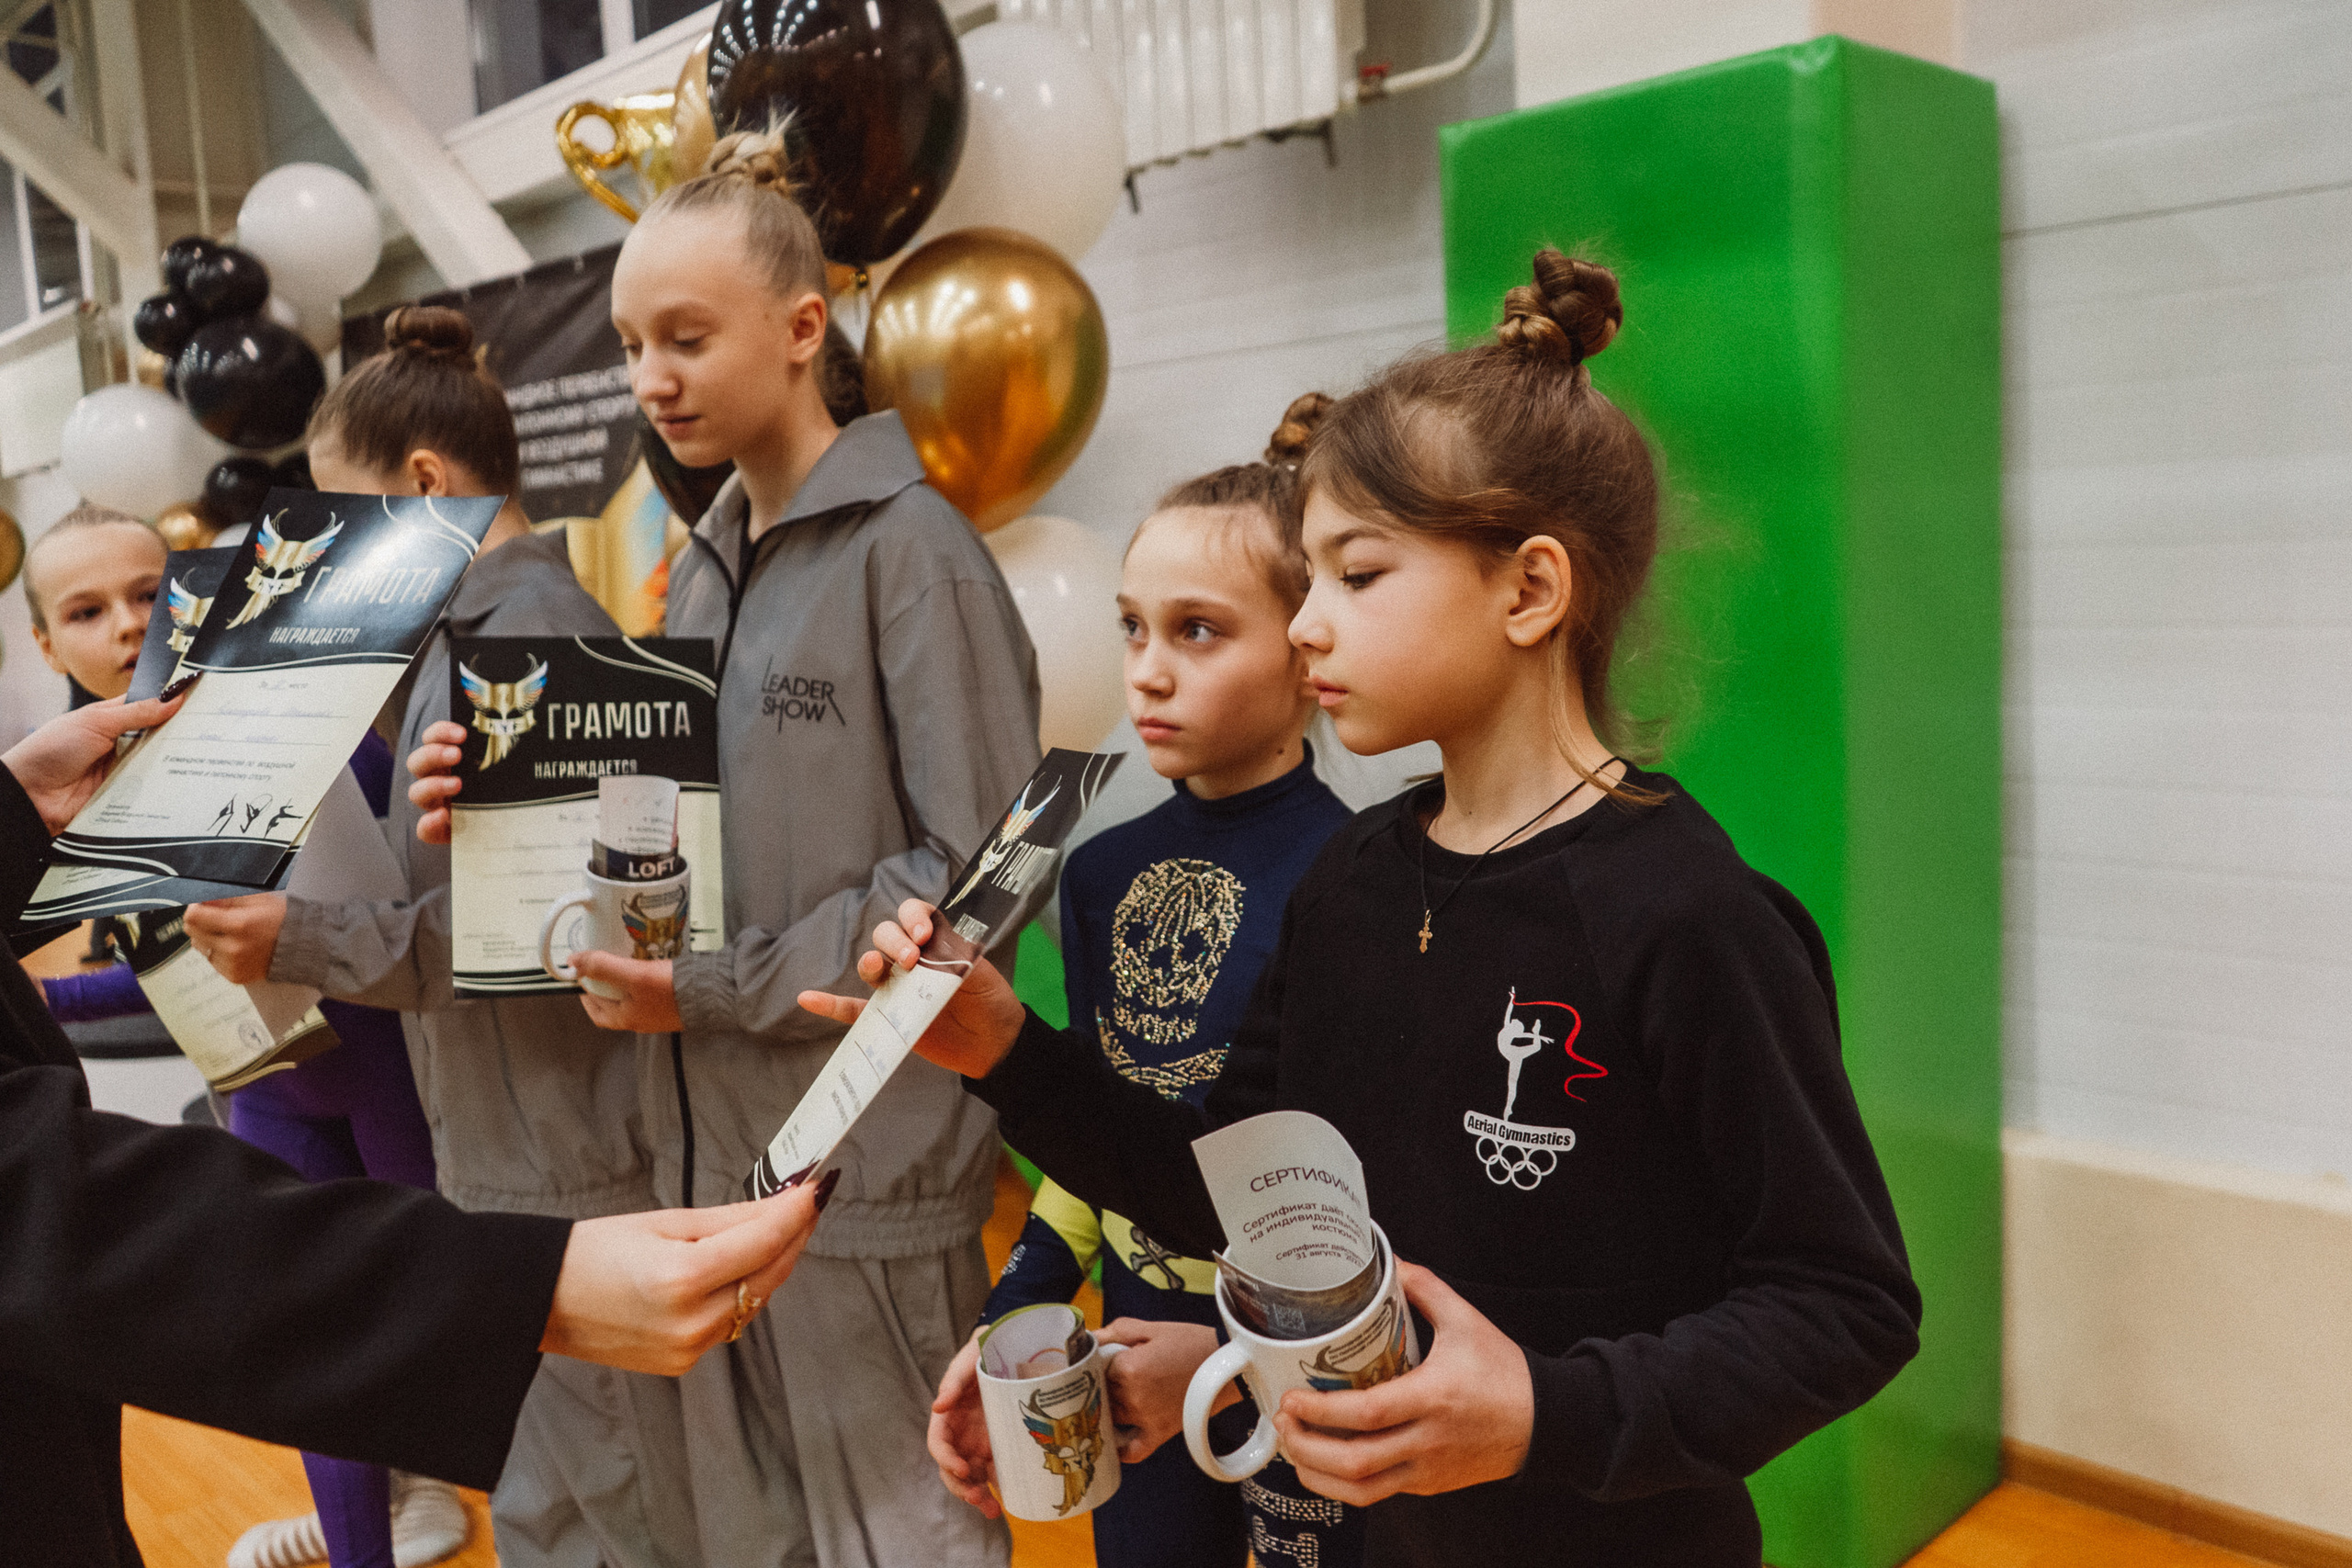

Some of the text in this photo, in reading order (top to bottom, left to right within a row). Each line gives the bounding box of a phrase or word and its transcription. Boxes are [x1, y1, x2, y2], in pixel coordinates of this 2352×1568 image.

[303, 566, 442, 604] ГРАМОТА
[269, 626, 360, 646] НАГРАЖДАЕТСЯ
[761, 654, 845, 727] LEADER
[548, 701, 691, 740] ГРАМОТА
[762, 694, 826, 733] SHOW
[534, 759, 638, 779] НАГРАЖДАЕТСЯ
[628, 857, 675, 878] LOFT
[1498, 1124, 1571, 1147] Gymnastics
[1243, 1202, 1317, 1233] Сертификат
[1250, 1230, 1264, 1243] на
[1295, 1251, 1306, 1260] 31
